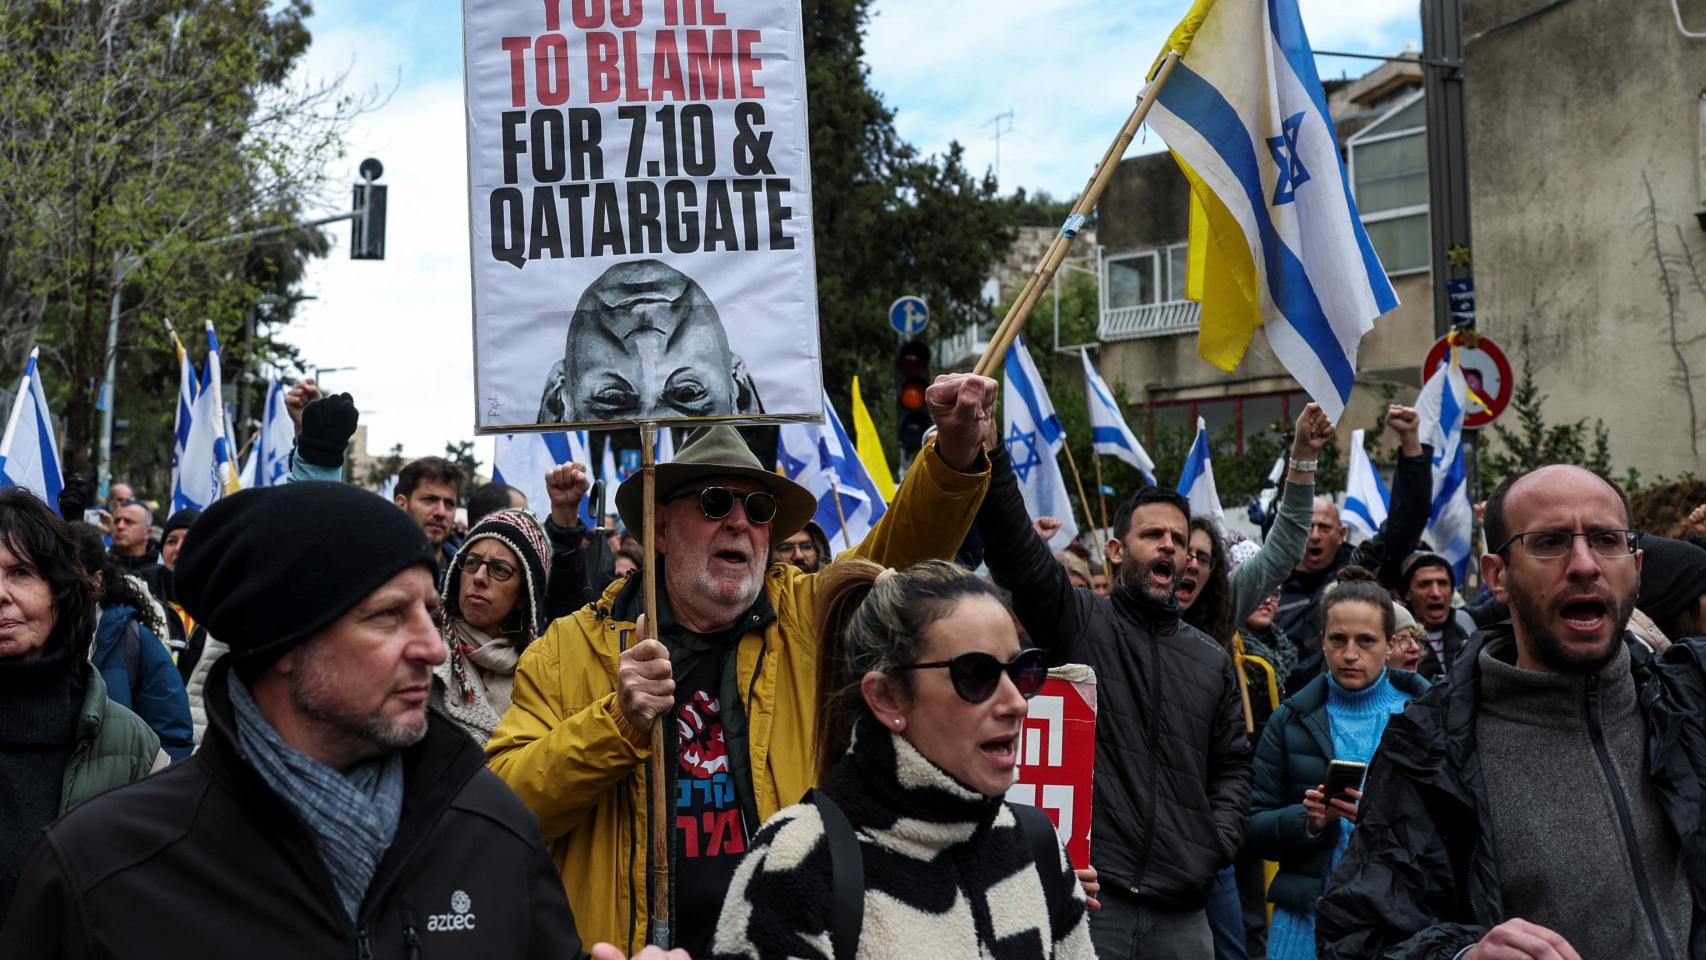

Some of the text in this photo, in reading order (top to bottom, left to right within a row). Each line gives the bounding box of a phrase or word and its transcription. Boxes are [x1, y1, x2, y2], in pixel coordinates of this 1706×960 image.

[501, 29, 766, 107] TO BLAME
[501, 101, 778, 185] FOR 7.10 &
[489, 177, 796, 270] QATARGATE
[426, 912, 476, 932] aztec
